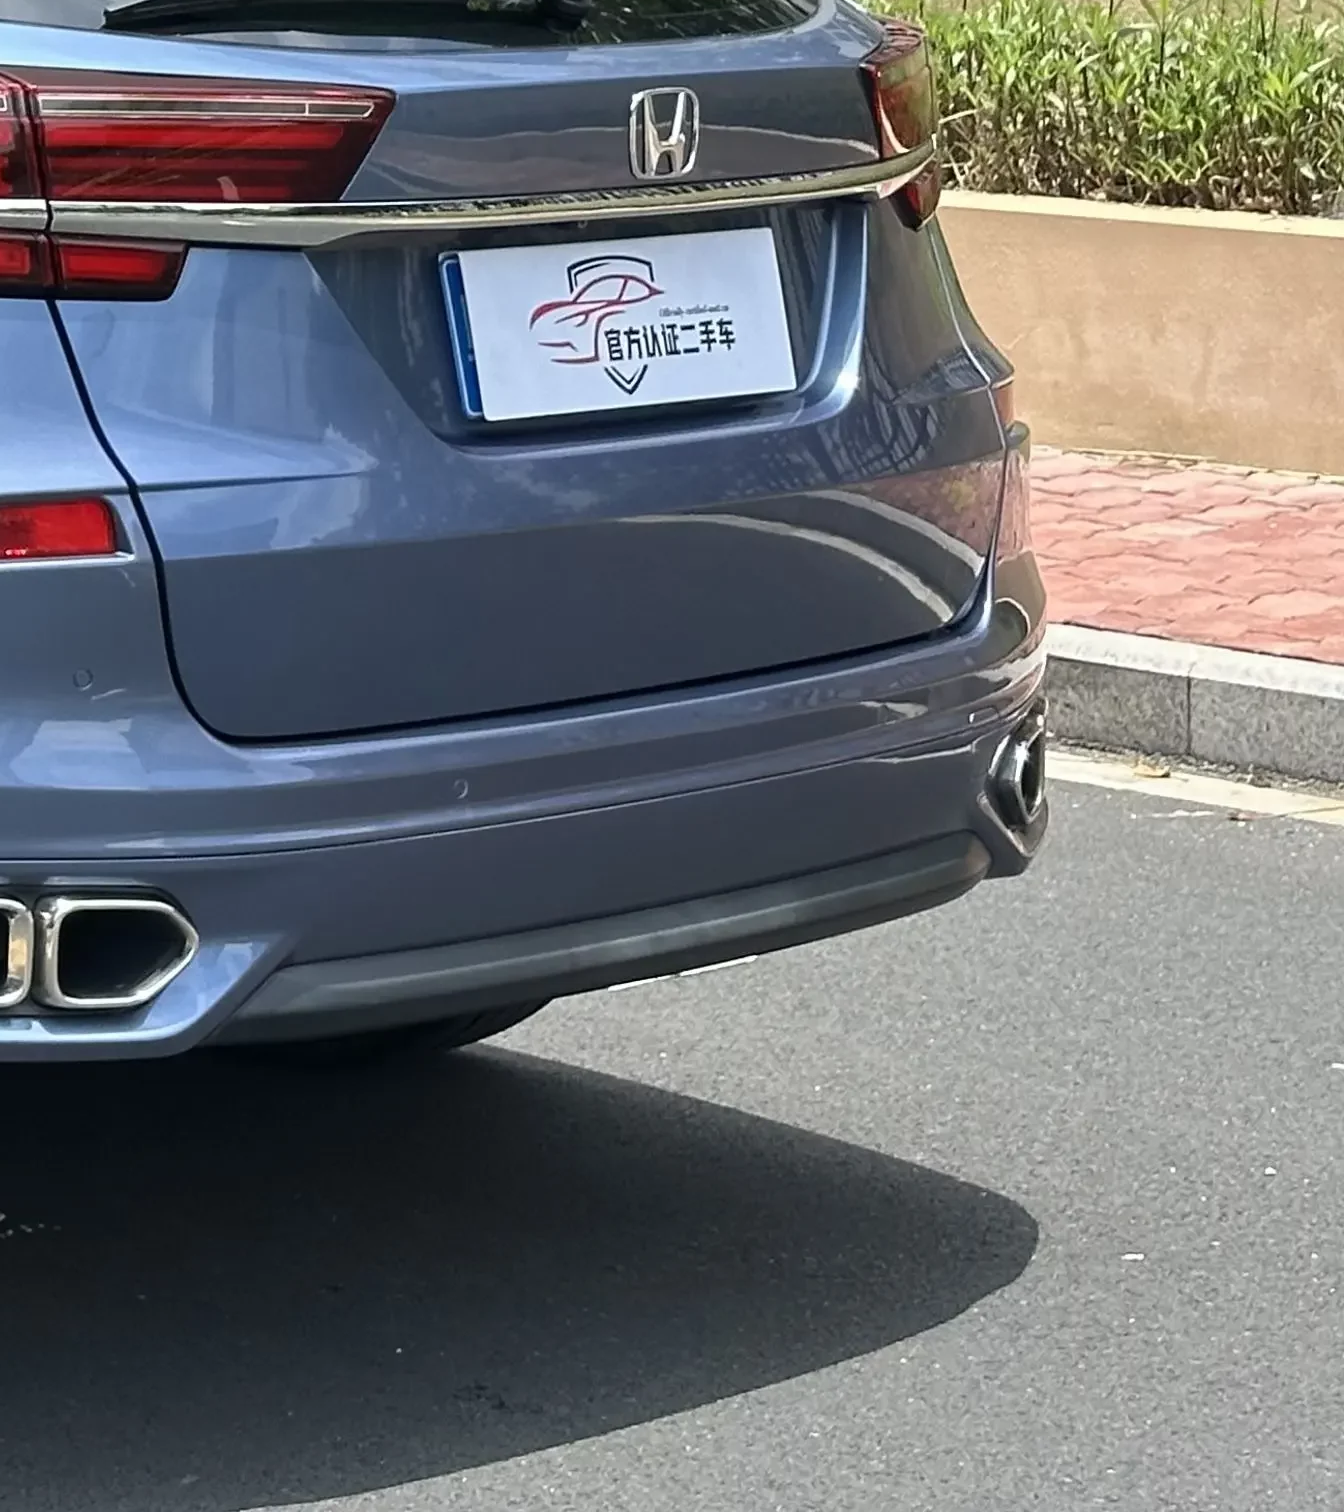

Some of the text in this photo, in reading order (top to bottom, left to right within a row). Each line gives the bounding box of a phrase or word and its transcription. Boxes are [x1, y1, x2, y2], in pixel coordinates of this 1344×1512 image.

[604, 318, 735, 361] 官方认证二手车
